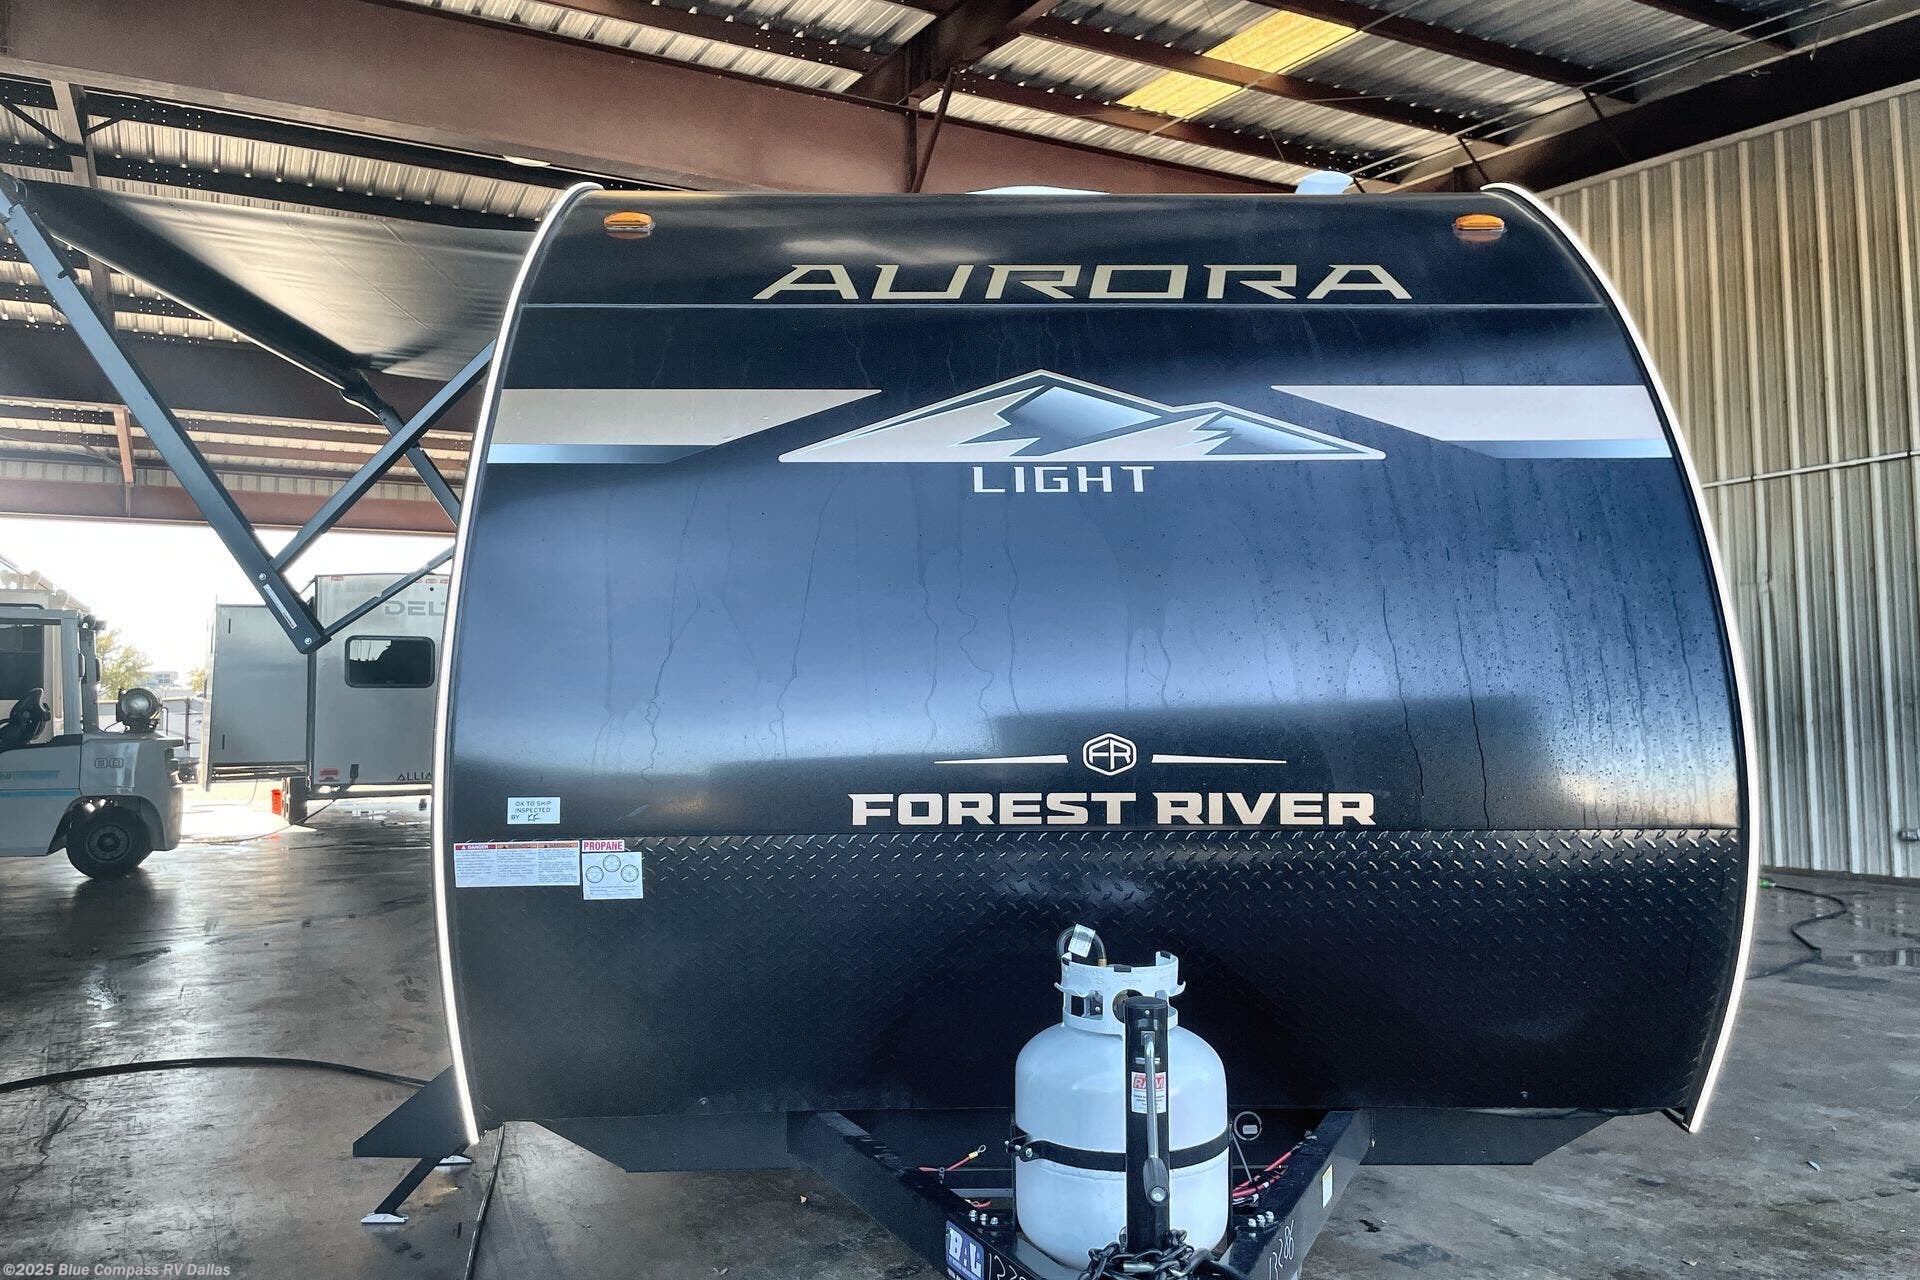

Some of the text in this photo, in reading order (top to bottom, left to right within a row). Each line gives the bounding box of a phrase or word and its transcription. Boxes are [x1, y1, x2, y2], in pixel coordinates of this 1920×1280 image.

[753, 264, 1413, 300] AURORA
[973, 466, 1154, 493] LIGHT
[385, 600, 446, 617] DEL
[848, 792, 1376, 826] FOREST RIVER
[583, 841, 623, 851] PROPANE
